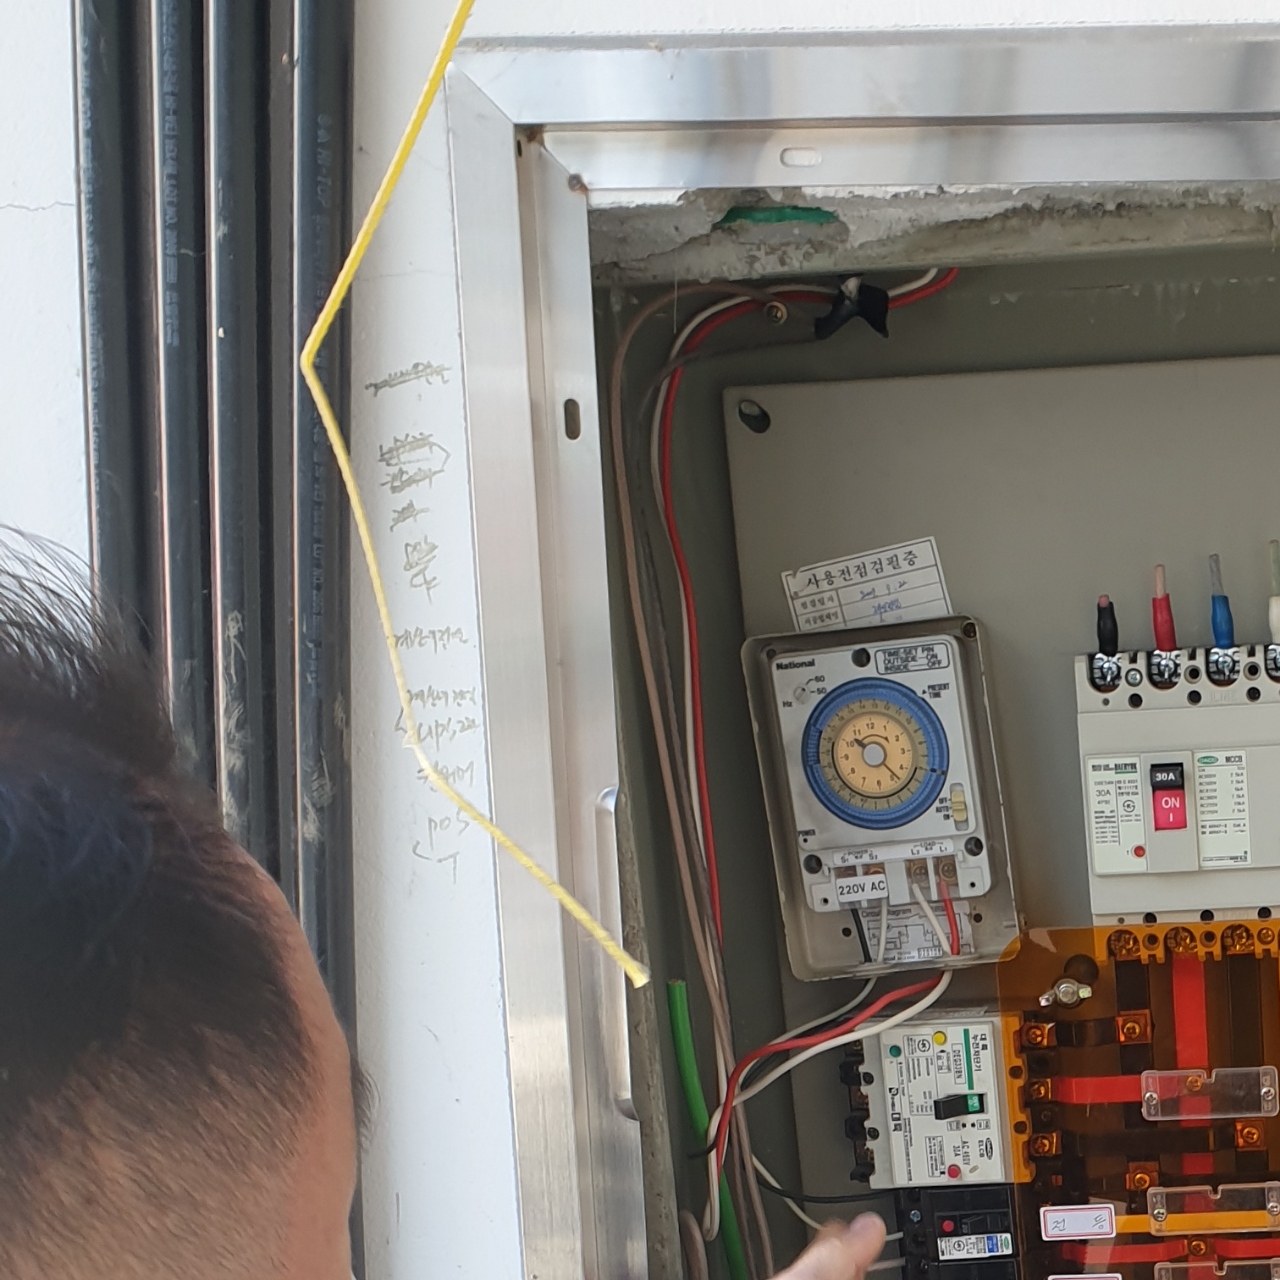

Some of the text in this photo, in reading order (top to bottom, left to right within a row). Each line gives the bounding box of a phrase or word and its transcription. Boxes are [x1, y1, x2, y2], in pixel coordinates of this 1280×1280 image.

[806, 551, 918, 589] 사용전점검필증
[776, 659, 815, 671] National
[816, 687, 827, 695] 50
[1155, 773, 1175, 781] 30A
[1161, 797, 1180, 808] ON
[838, 880, 886, 896] 220V AC
